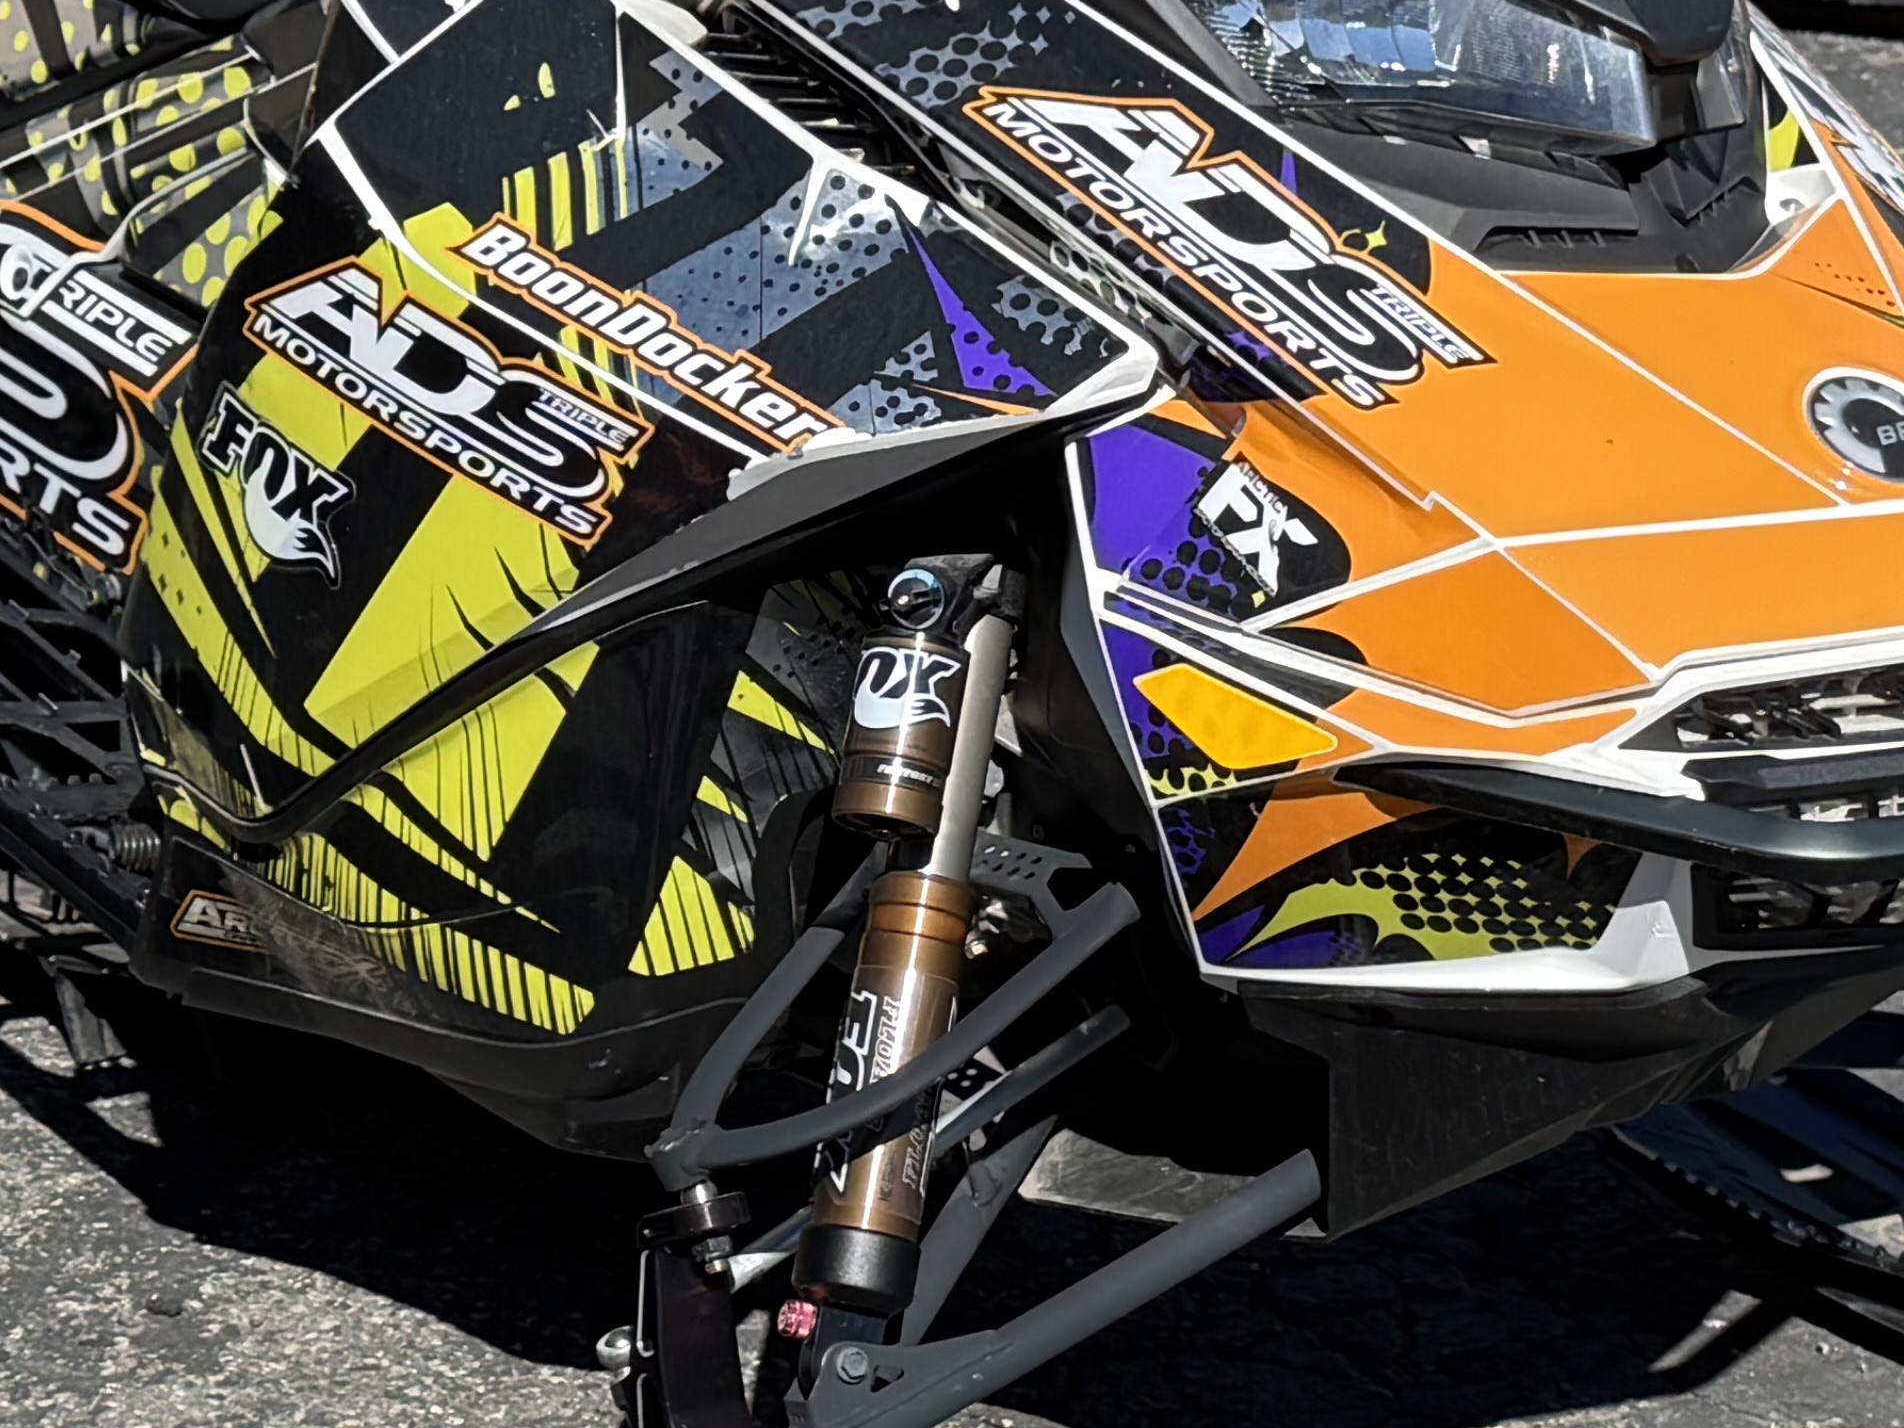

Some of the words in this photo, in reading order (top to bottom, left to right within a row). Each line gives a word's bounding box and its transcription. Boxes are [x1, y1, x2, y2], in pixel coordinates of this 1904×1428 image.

[461, 223, 828, 440] BoonDocker
[983, 103, 1387, 407] MOTORSPORTS
[1019, 98, 1420, 382] ADS
[1374, 283, 1471, 360] TRIPLE
[202, 392, 349, 547] FOX
[253, 312, 600, 537] MOTORSPORTS
[268, 268, 610, 499] ADS
[537, 387, 635, 445] TRIPLE
[853, 646, 961, 722] OX
